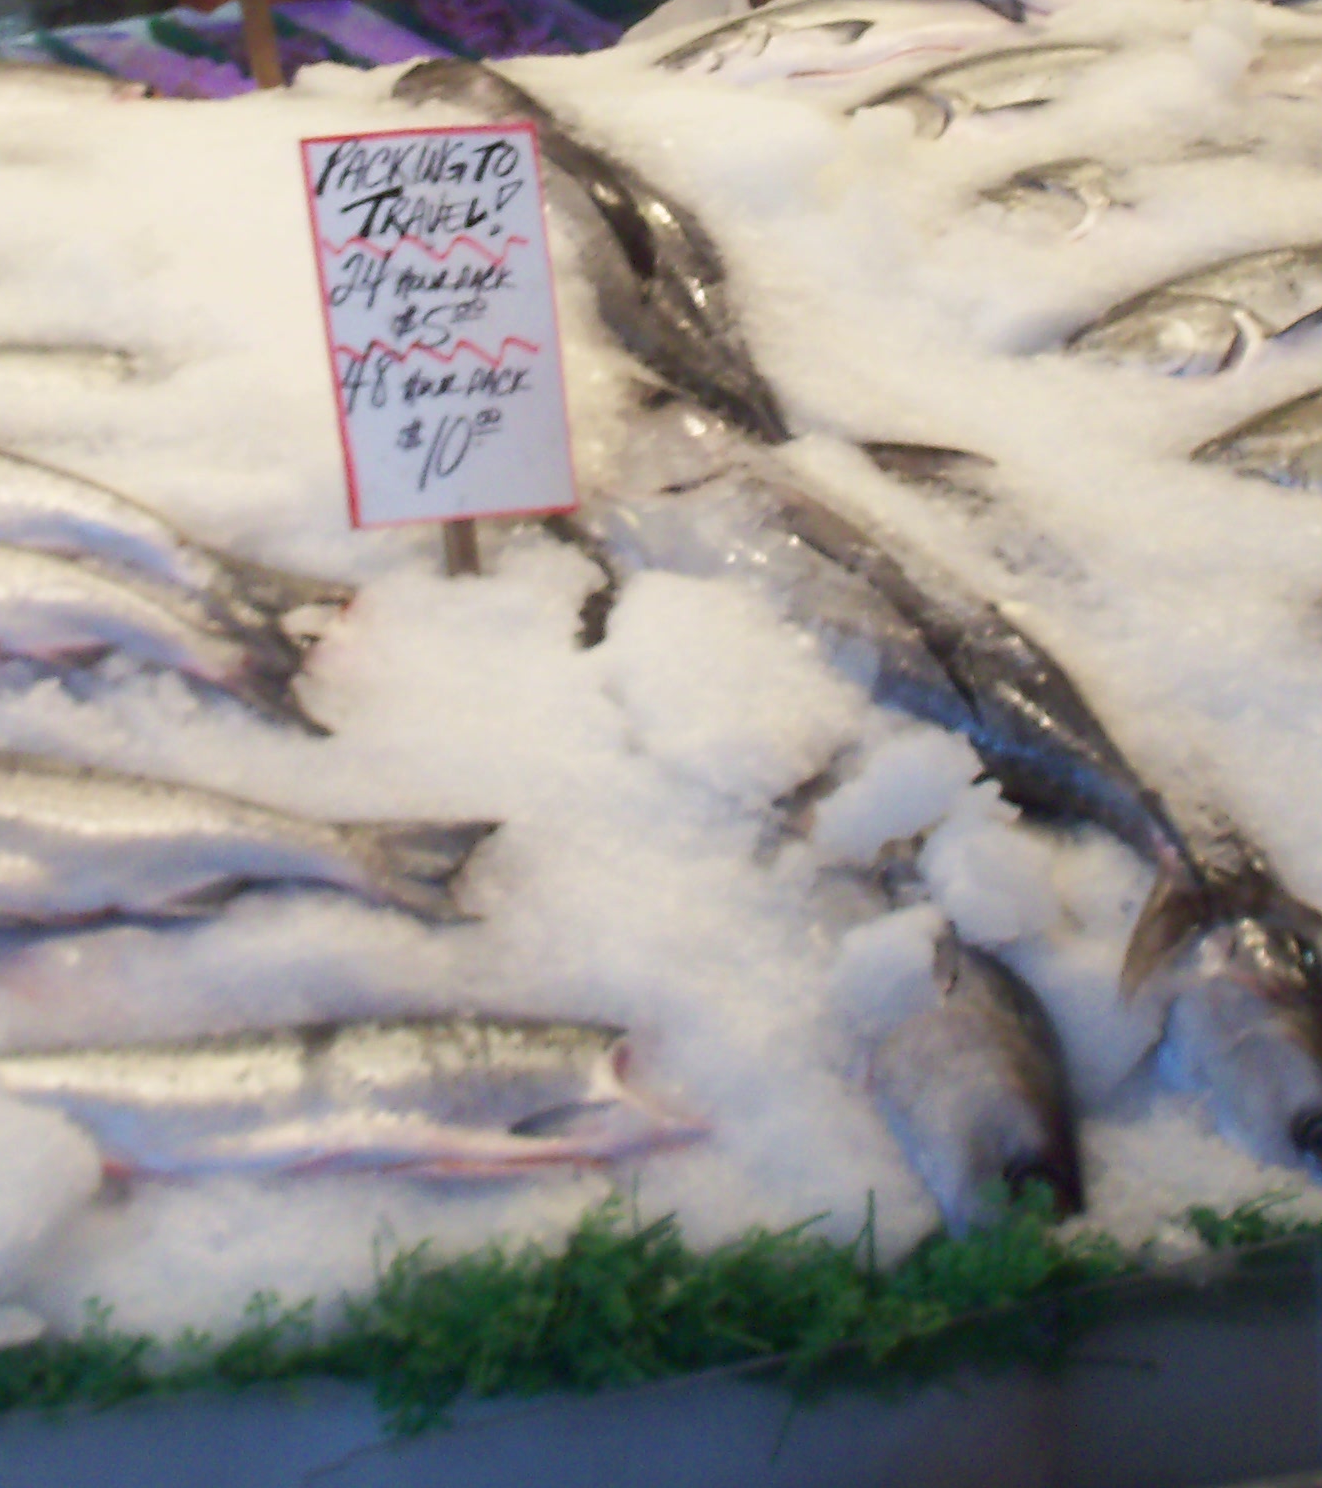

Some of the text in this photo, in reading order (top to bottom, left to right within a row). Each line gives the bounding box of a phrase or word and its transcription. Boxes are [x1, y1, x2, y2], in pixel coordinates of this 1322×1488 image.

[316, 136, 520, 196] PACKING TO
[330, 250, 391, 308] 24
[342, 339, 392, 415] 48
[465, 367, 533, 399] PACK
